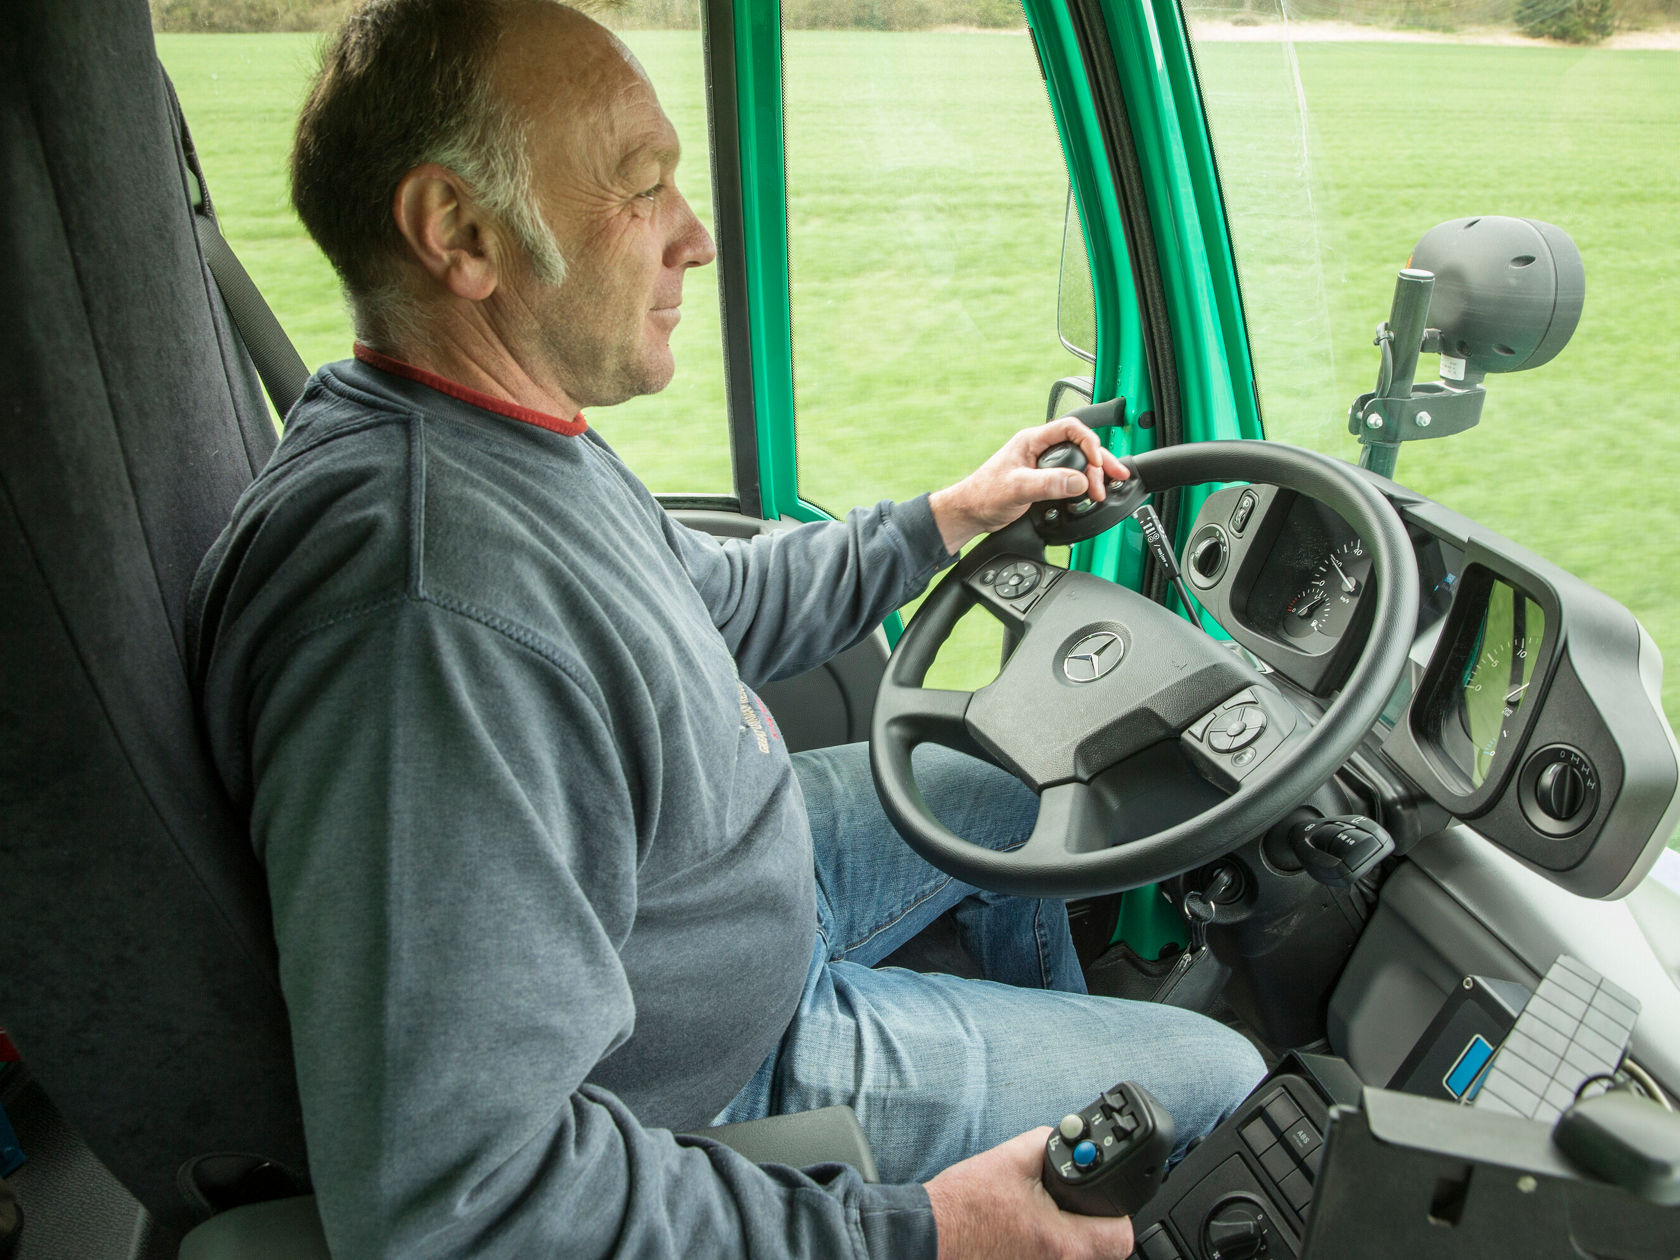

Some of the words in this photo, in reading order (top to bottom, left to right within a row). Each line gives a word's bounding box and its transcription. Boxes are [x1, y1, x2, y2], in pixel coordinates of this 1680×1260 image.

[1516, 649, 1527, 658] 10
[1491, 659, 1500, 668] 5
[1474, 684, 1482, 692] 0
[1560, 750, 1565, 758] 0
[1296, 1130, 1310, 1144] ABS
